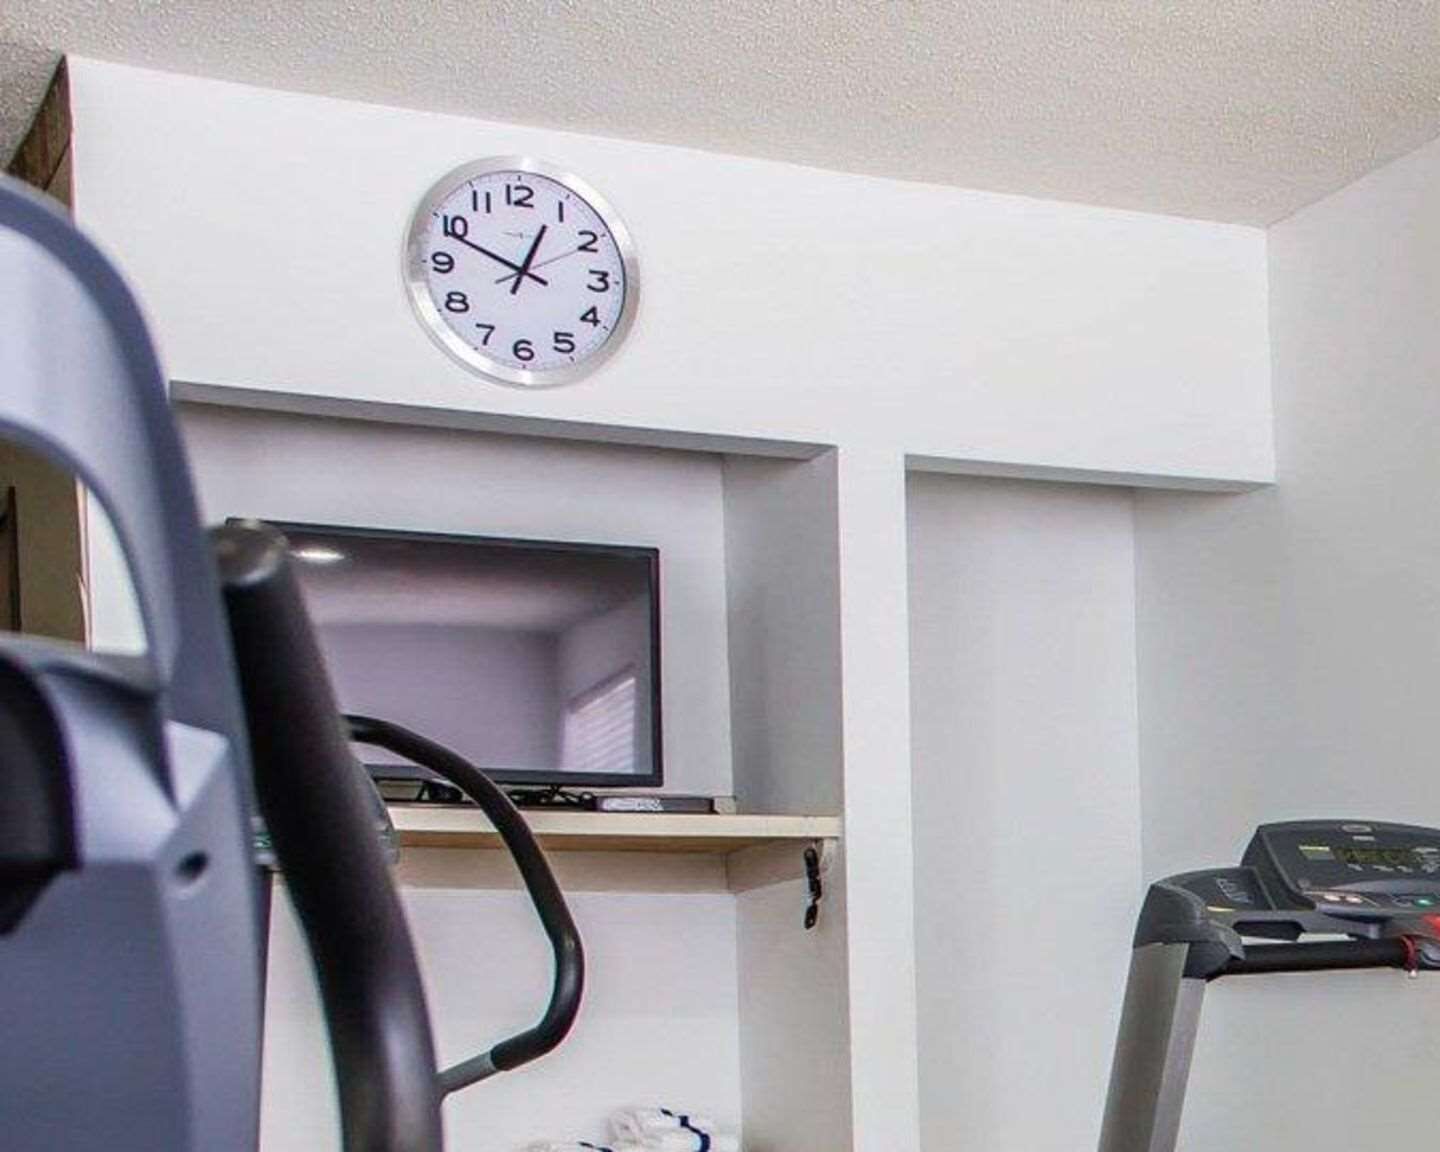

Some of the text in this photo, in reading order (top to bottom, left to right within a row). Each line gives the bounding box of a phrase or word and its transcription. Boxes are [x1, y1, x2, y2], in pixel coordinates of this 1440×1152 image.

[472, 191, 491, 213] 11
[506, 185, 534, 208] 12
[558, 202, 563, 222] 1
[443, 215, 468, 238] 10
[578, 232, 598, 252] 2
[431, 253, 454, 273] 9
[587, 271, 609, 292] 3
[445, 292, 469, 312] 8
[580, 307, 600, 327] 4
[476, 324, 495, 345] 7
[553, 333, 575, 353] 5
[513, 340, 534, 361] 6
